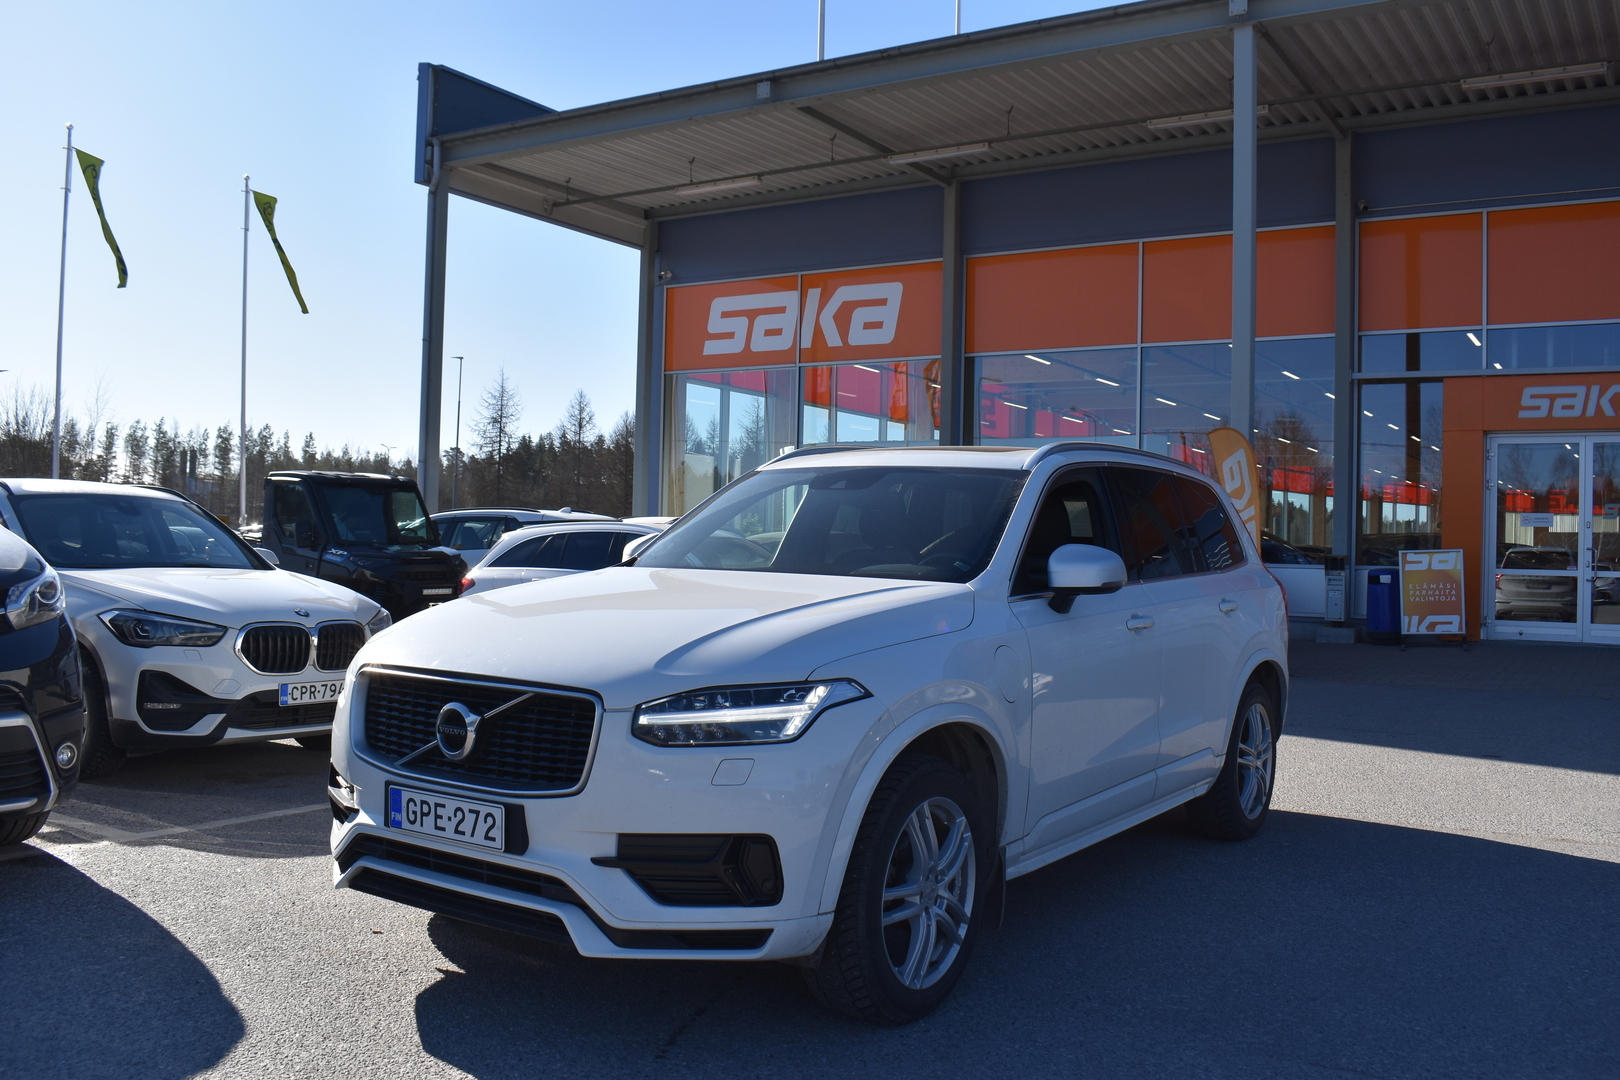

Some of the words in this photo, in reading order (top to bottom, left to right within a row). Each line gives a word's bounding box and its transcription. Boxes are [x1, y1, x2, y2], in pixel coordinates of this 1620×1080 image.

[1518, 384, 1620, 418] sak
[438, 726, 466, 736] VOLVO
[391, 811, 402, 822] FIN
[406, 797, 497, 842] GPE-272
